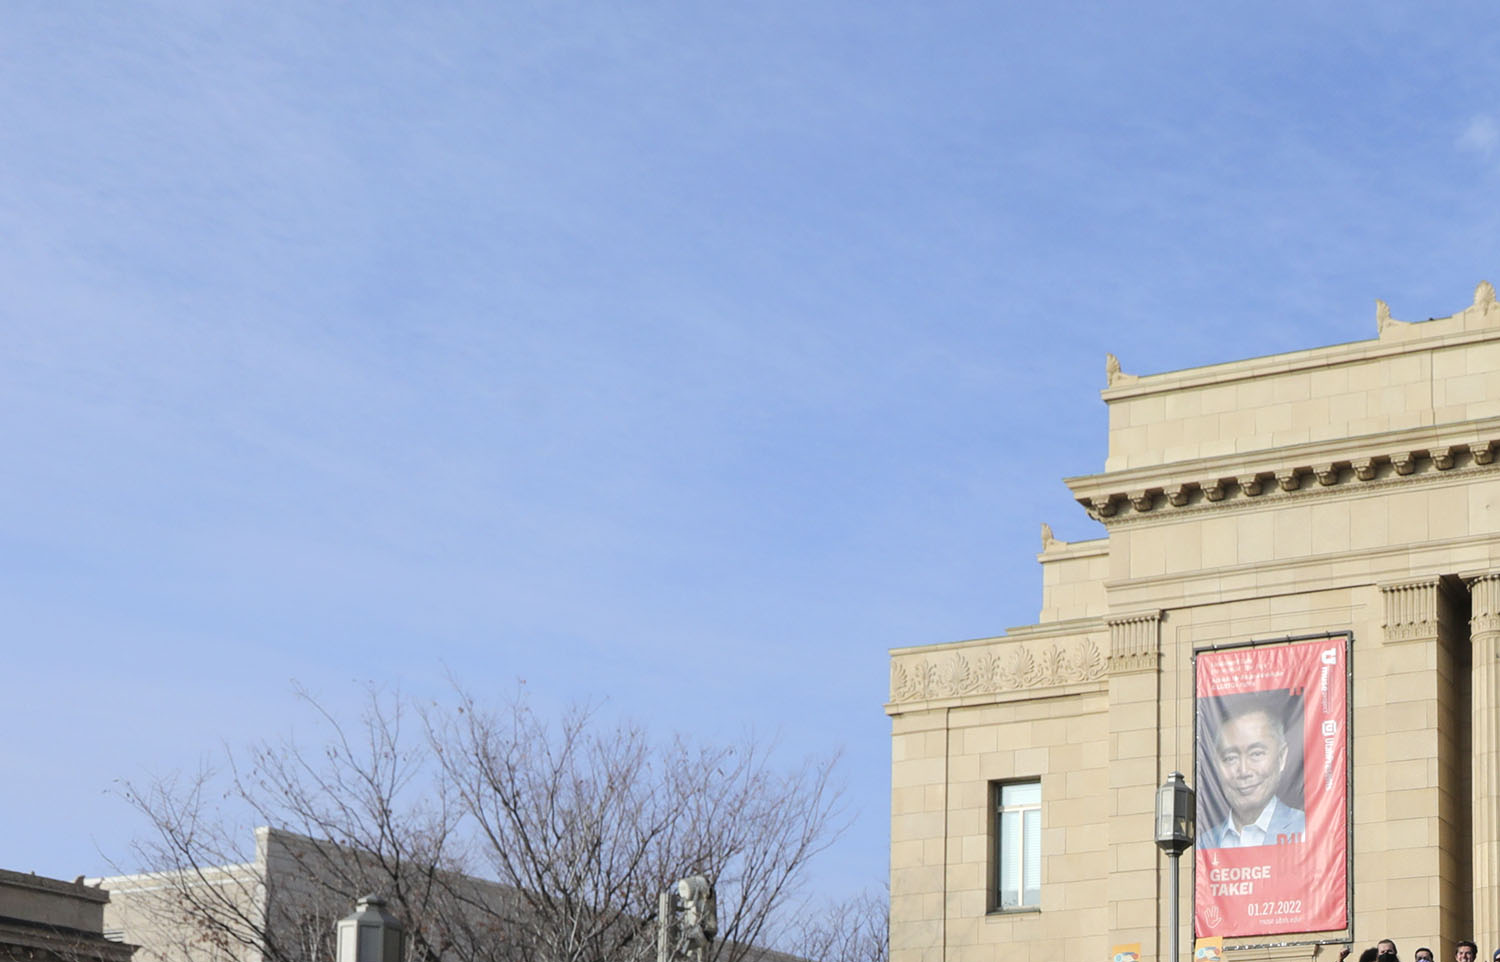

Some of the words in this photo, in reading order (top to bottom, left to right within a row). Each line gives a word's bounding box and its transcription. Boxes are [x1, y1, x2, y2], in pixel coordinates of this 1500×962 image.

[1210, 865, 1271, 881] GEORGE
[1211, 881, 1254, 897] TAKEI
[1247, 900, 1302, 917] 01.27.2022
